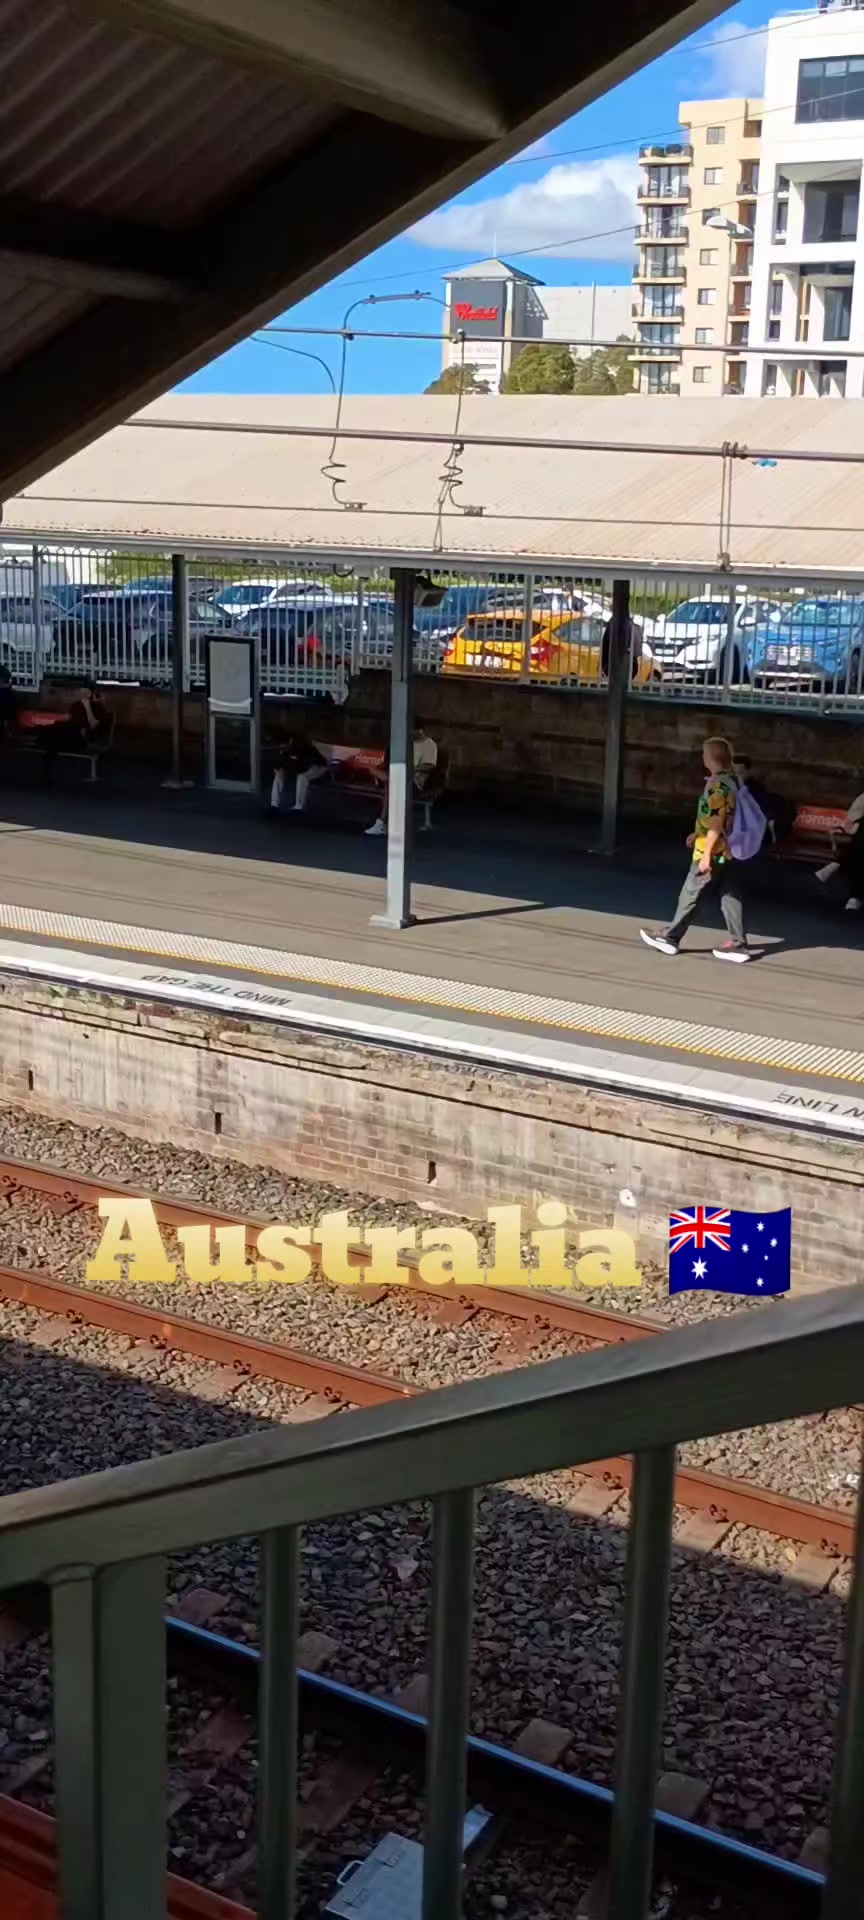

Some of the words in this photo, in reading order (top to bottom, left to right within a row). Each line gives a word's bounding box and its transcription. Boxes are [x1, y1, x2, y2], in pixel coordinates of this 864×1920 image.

[141, 975, 189, 985] GAP
[191, 981, 230, 994] THE
[234, 990, 292, 1005] MIND
[772, 1093, 839, 1112] LINE
